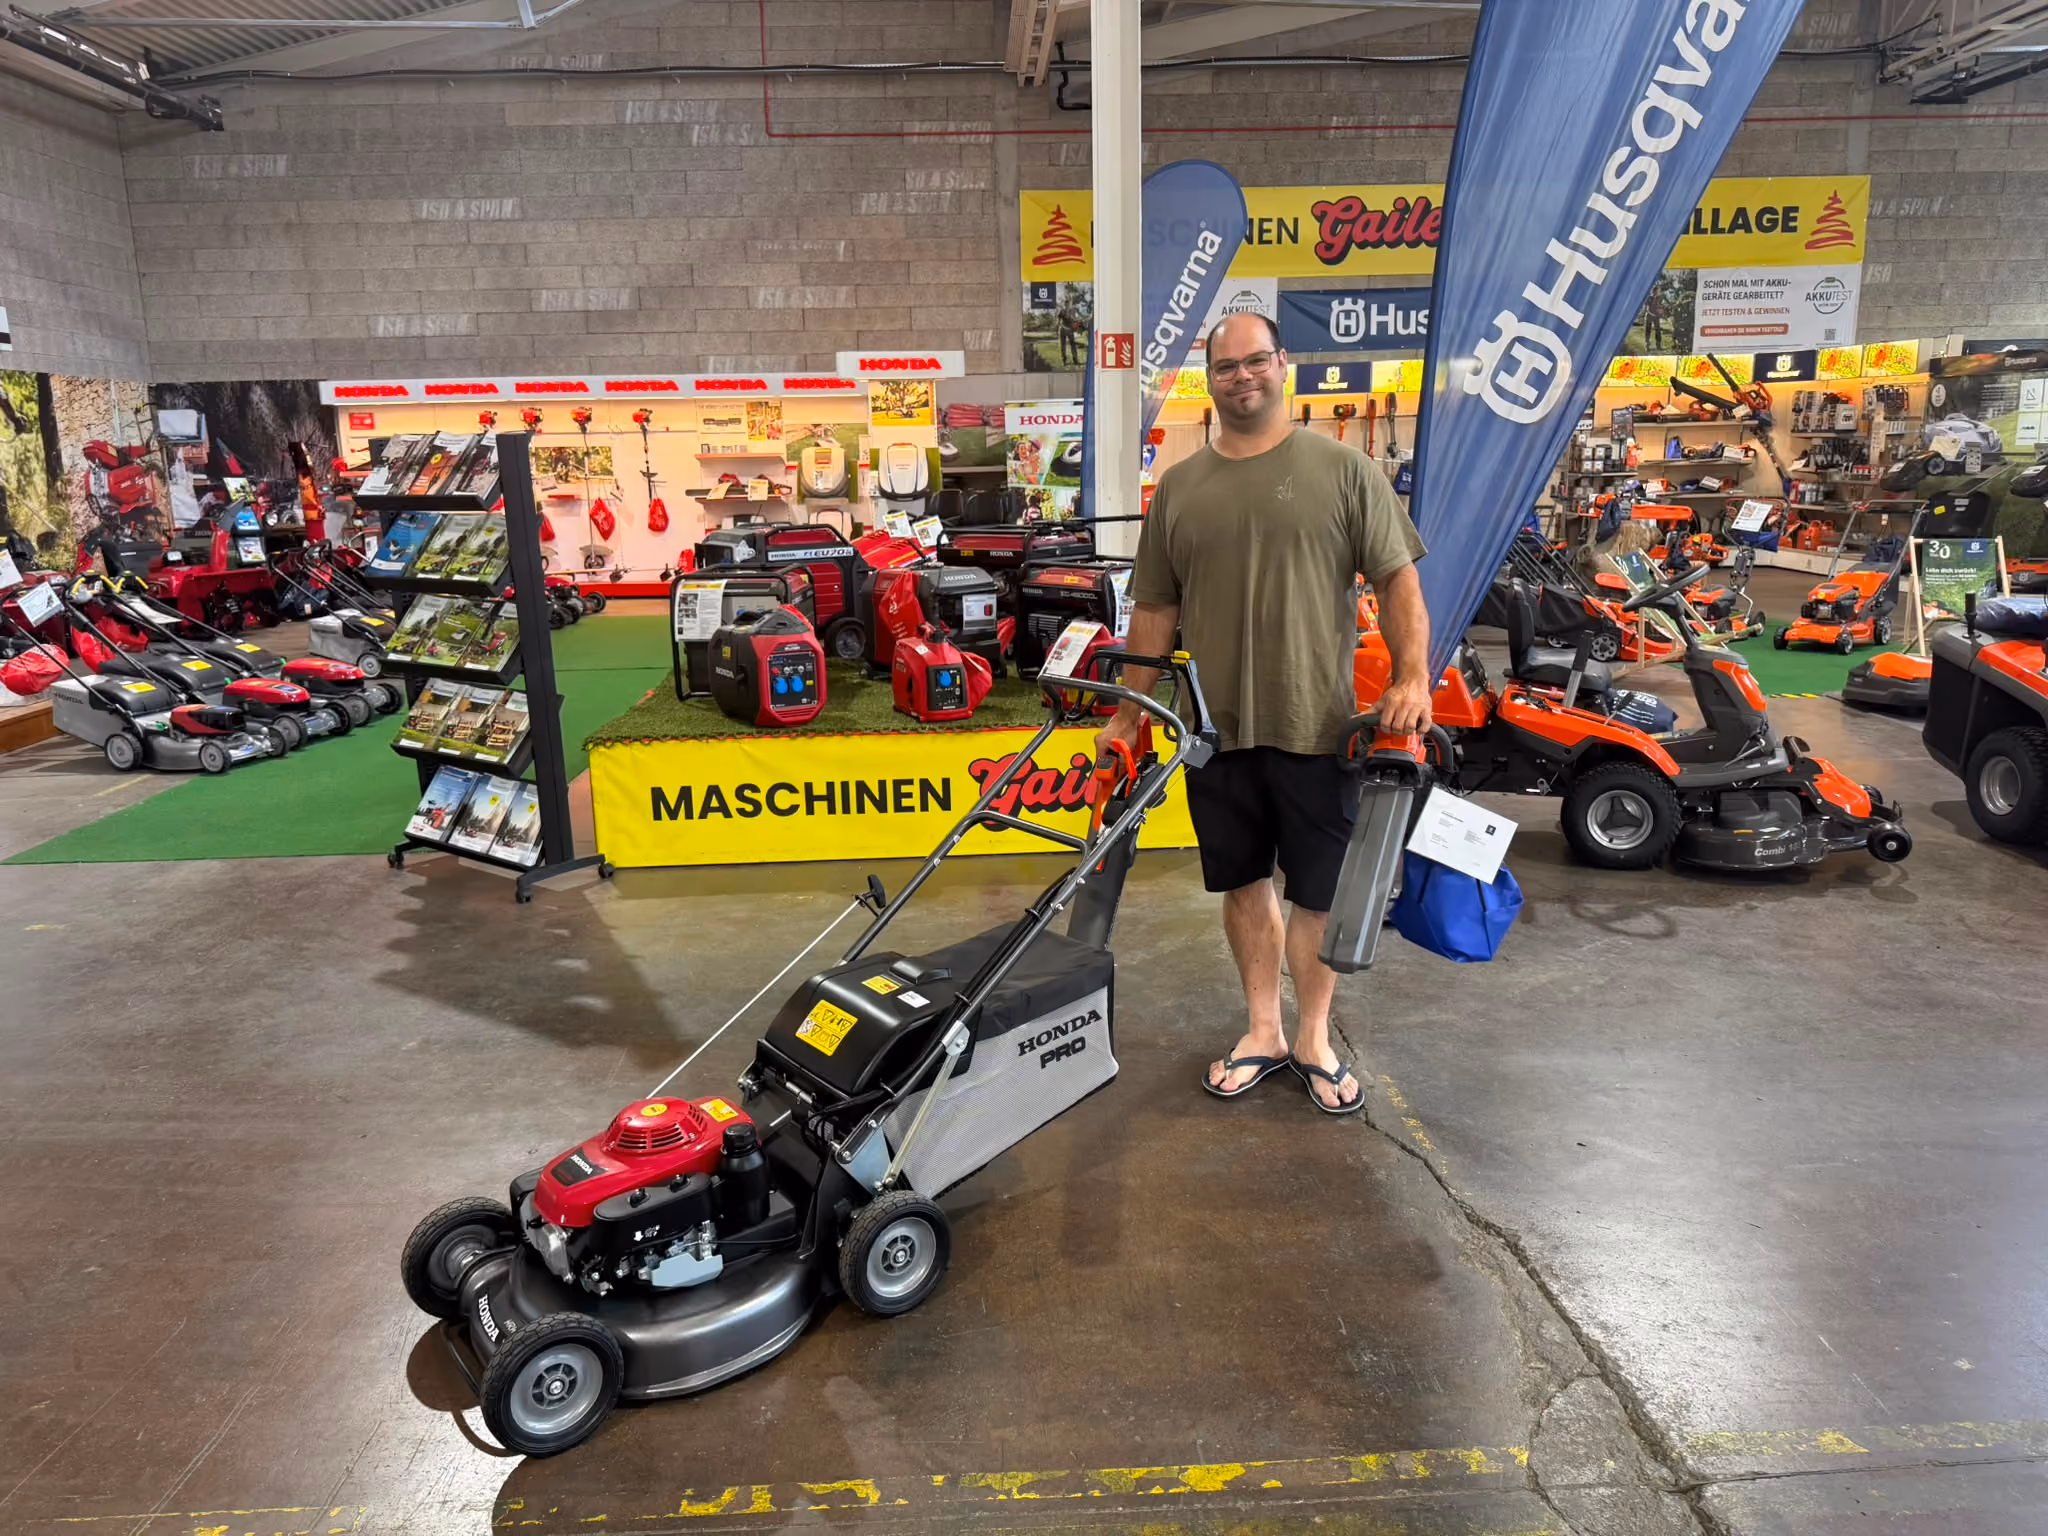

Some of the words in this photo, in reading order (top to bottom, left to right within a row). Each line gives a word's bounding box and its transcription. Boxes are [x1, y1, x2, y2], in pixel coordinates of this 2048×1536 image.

[1522, 0, 1748, 330] Husqva
[1703, 279, 1730, 289] SCHON
[1731, 279, 1748, 288] MAL
[1750, 278, 1763, 287] MIT
[1766, 278, 1792, 287] AKKU-
[1702, 290, 1731, 301] GERÄTE
[1733, 290, 1784, 301] GEARBEITET?
[1805, 290, 1853, 302] AKKUTEST
[1141, 230, 1223, 392] usqvarna
[859, 358, 943, 371] HONDA
[425, 384, 499, 396] HONDA
[515, 381, 589, 393] HONDA
[605, 380, 679, 392] HONDA
[695, 378, 768, 391] HONDA
[783, 377, 856, 390] HONDA
[334, 386, 409, 398] HONDA
[1019, 414, 1084, 426] HONDA
[944, 573, 977, 582] HONDA
[651, 777, 952, 821] MASCHINEN
[1017, 1009, 1102, 1057] HONDA
[1040, 1036, 1086, 1069] PRO
[572, 1153, 593, 1175] HONDA
[478, 1294, 499, 1342] HONDA
